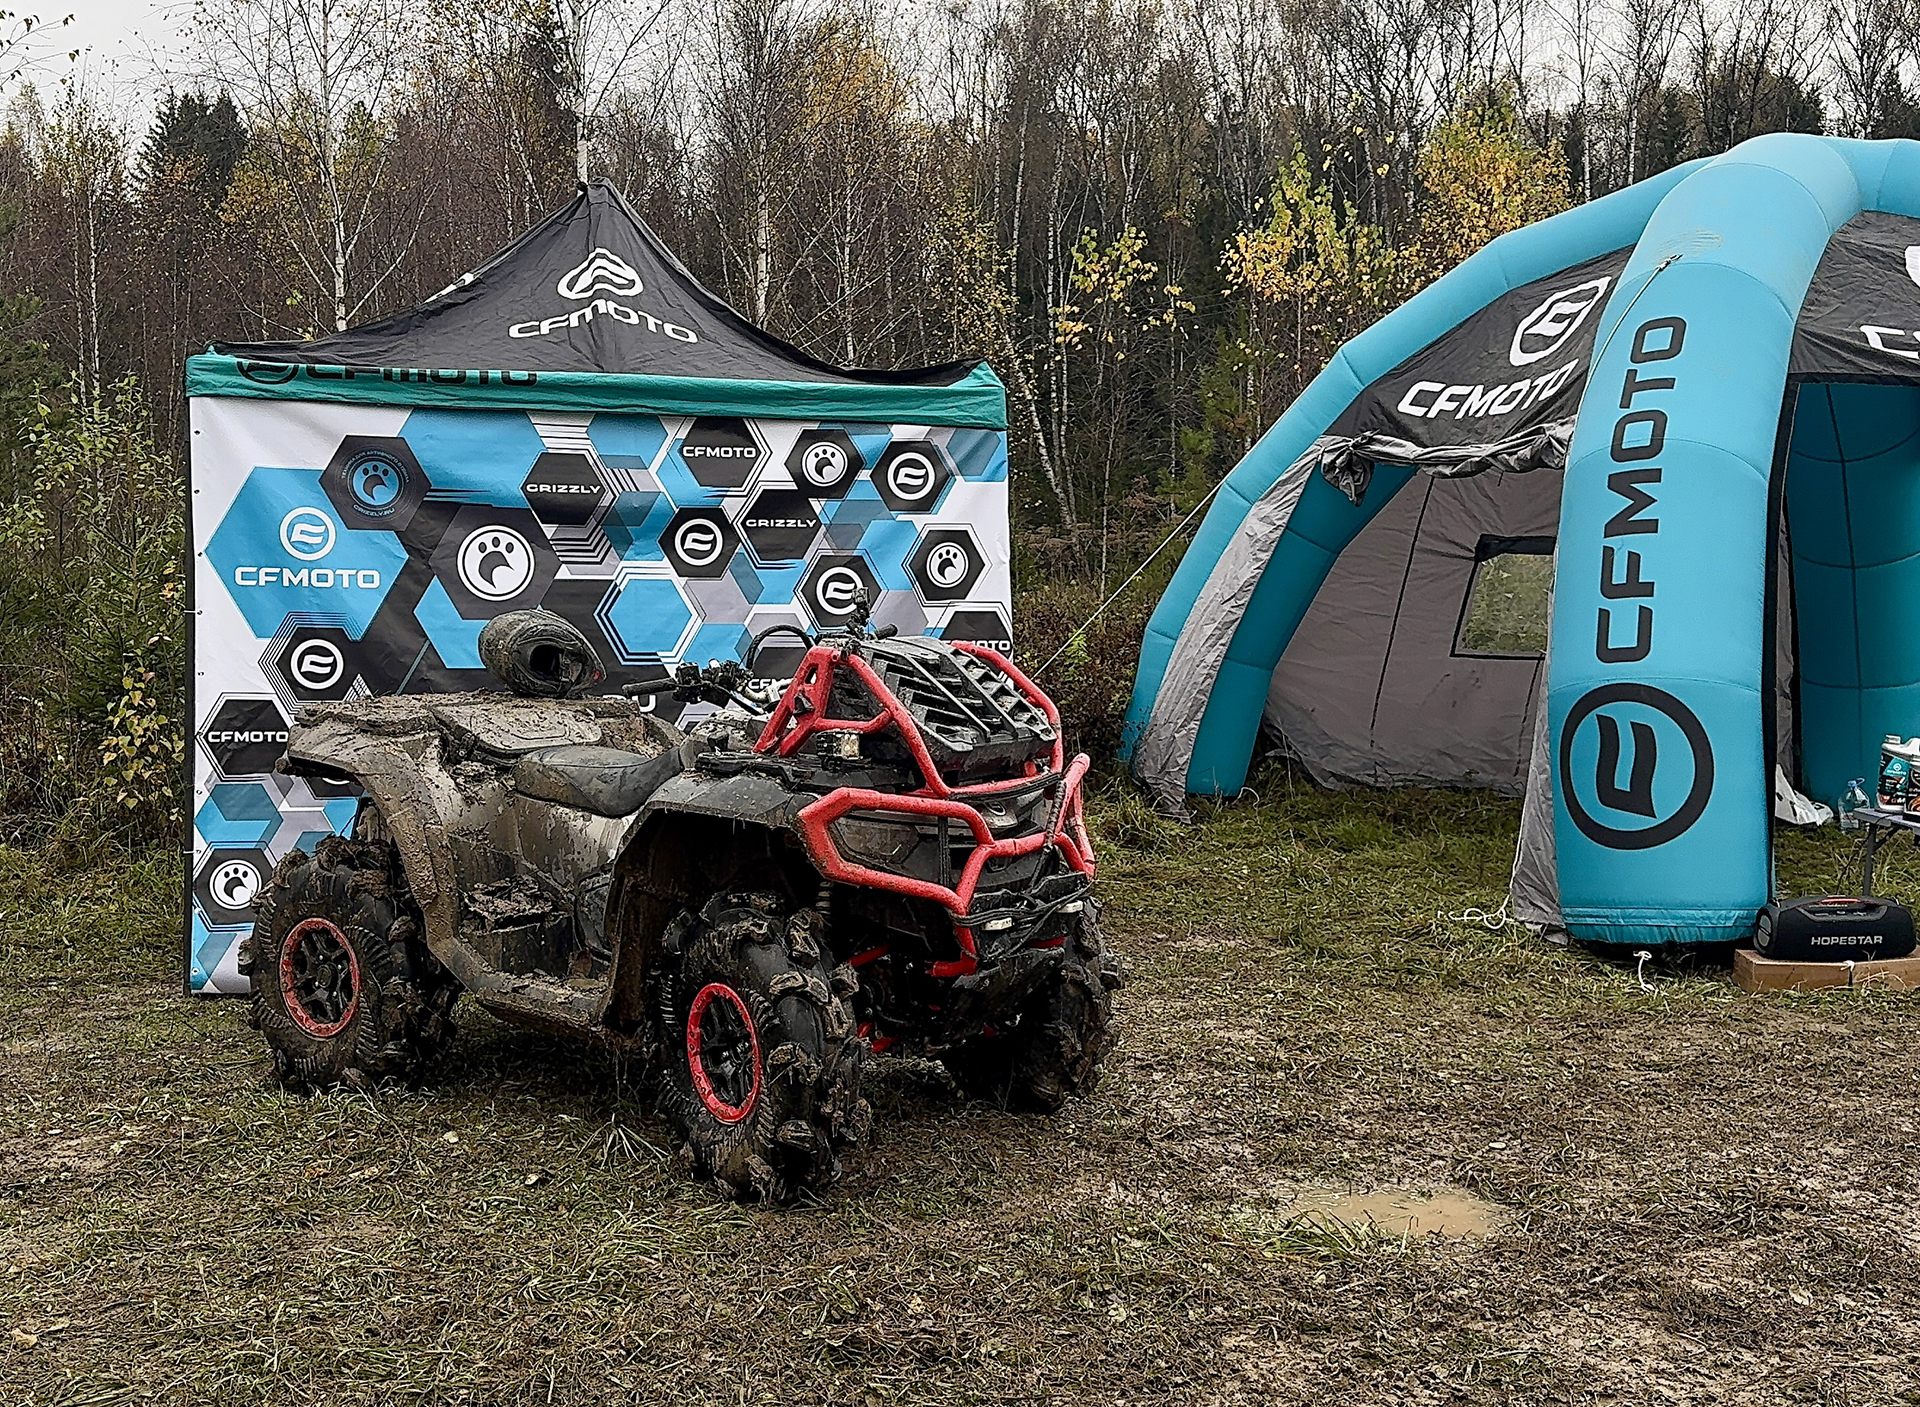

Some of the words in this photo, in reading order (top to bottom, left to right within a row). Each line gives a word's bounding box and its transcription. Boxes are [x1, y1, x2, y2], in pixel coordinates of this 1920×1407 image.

[508, 298, 699, 344] CFMOTO
[1397, 358, 1578, 419] CFMOTO
[682, 445, 757, 459] CFMOTO
[526, 483, 602, 495] GRIZZLY
[1596, 316, 1688, 665] CFMOTO
[746, 518, 817, 529] GRIZZLY
[234, 567, 381, 589] CFMOTO
[207, 731, 289, 743] CFMOTO
[1811, 935, 1883, 945] HOPESTAR
